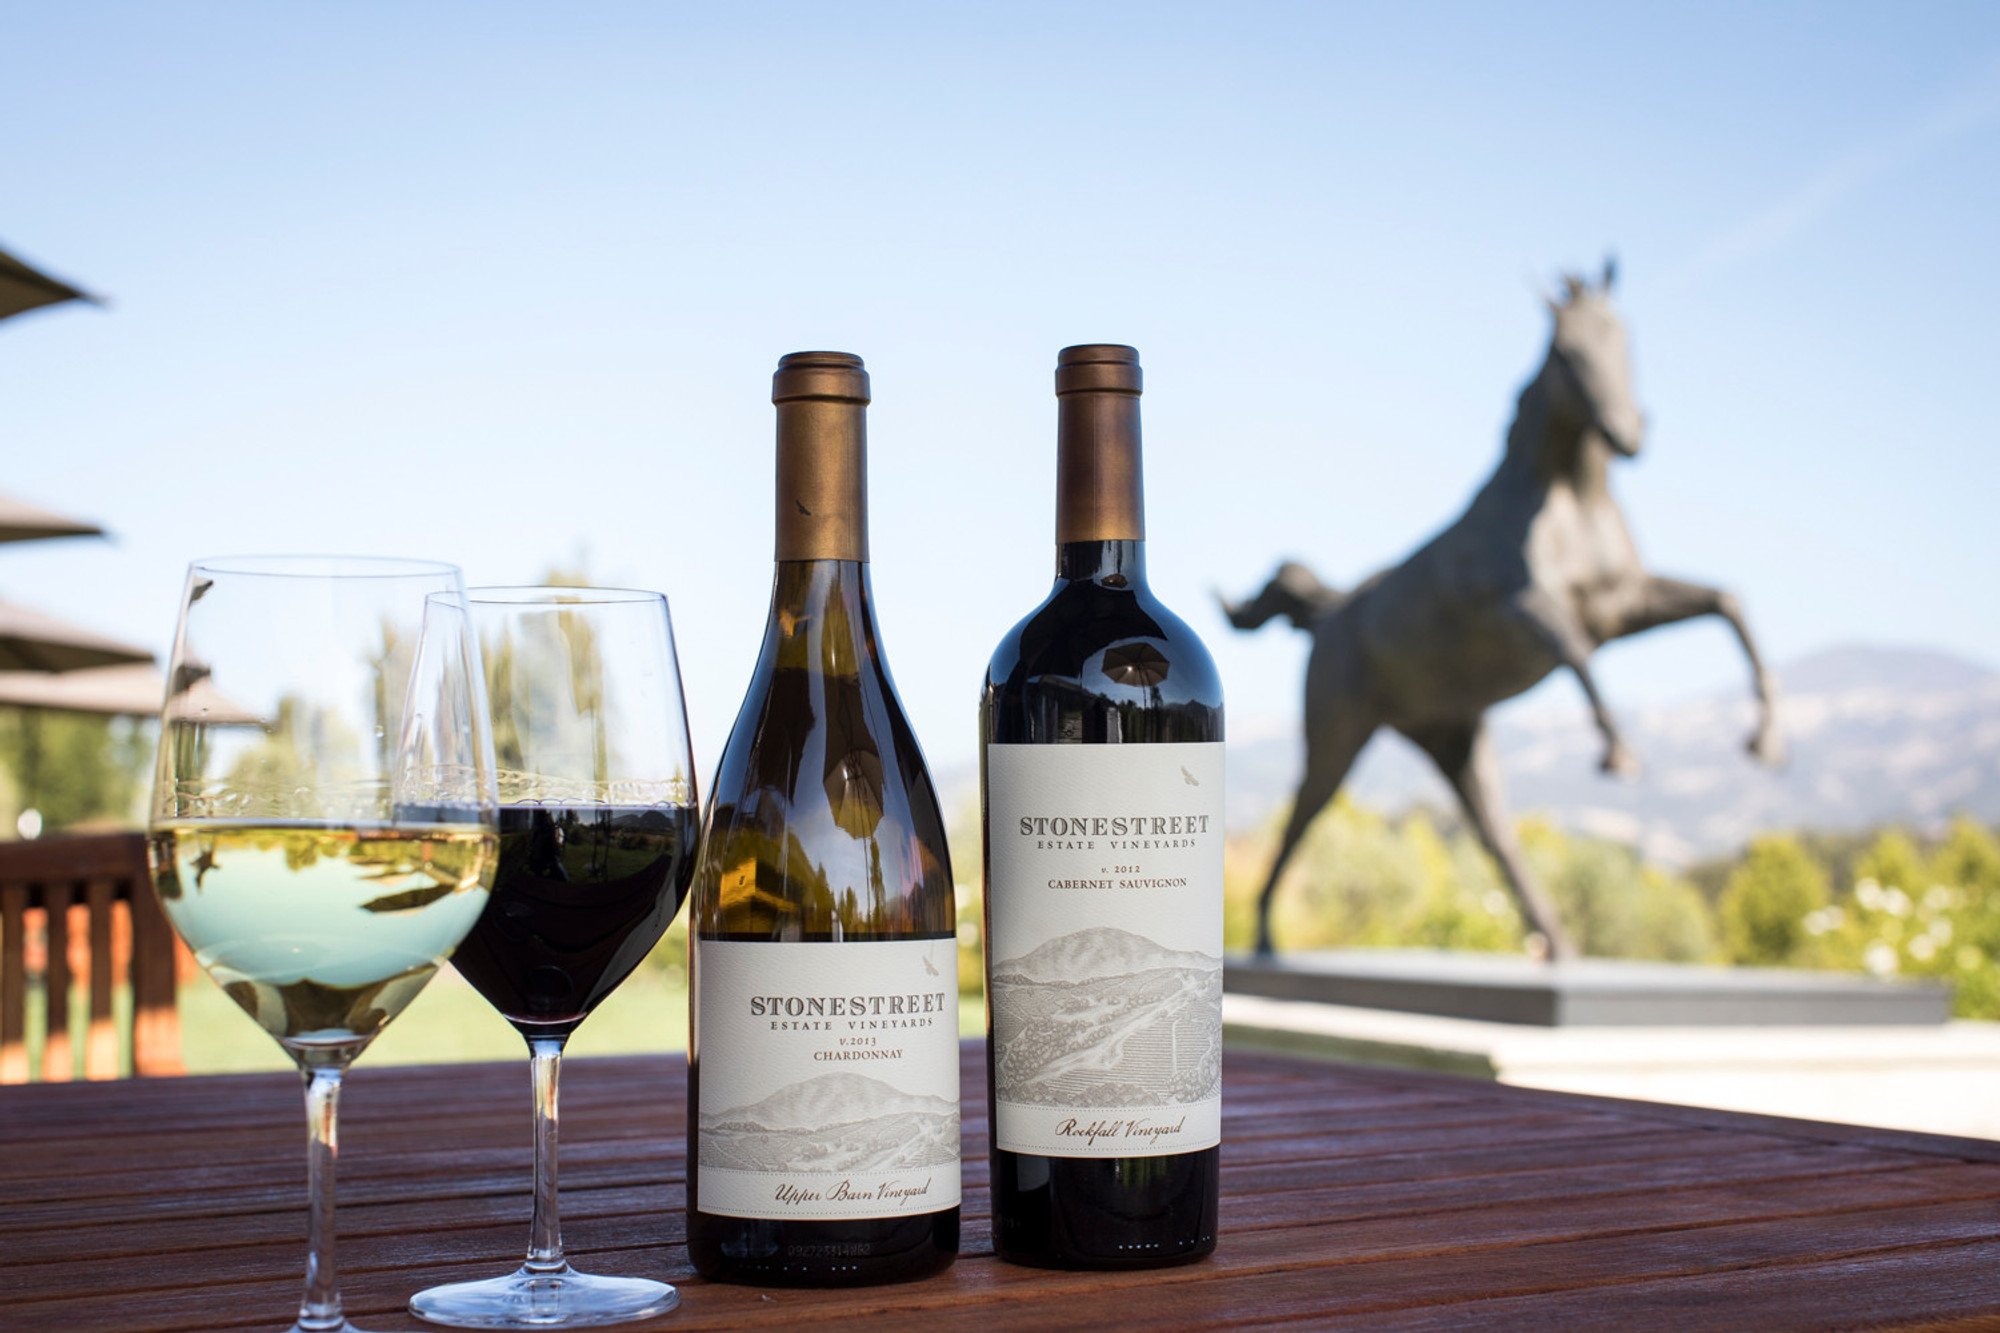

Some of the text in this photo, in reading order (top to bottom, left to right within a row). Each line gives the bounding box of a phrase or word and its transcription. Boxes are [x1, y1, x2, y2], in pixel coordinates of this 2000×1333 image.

[1019, 814, 1209, 836] STONESTREET
[1037, 838, 1196, 850] ESTATE VINEYARDS
[1114, 865, 1141, 874] 2012
[1047, 877, 1187, 890] CABERNET SAUVIGNON
[750, 992, 945, 1017] STONESTREET
[770, 1017, 933, 1031] ESTATE VINEYARDS
[813, 1048, 903, 1062] CHARDONNAY
[1055, 1115, 1186, 1146] Rockfall Vineyard
[774, 1176, 932, 1207] Upper Barn Vineyard
